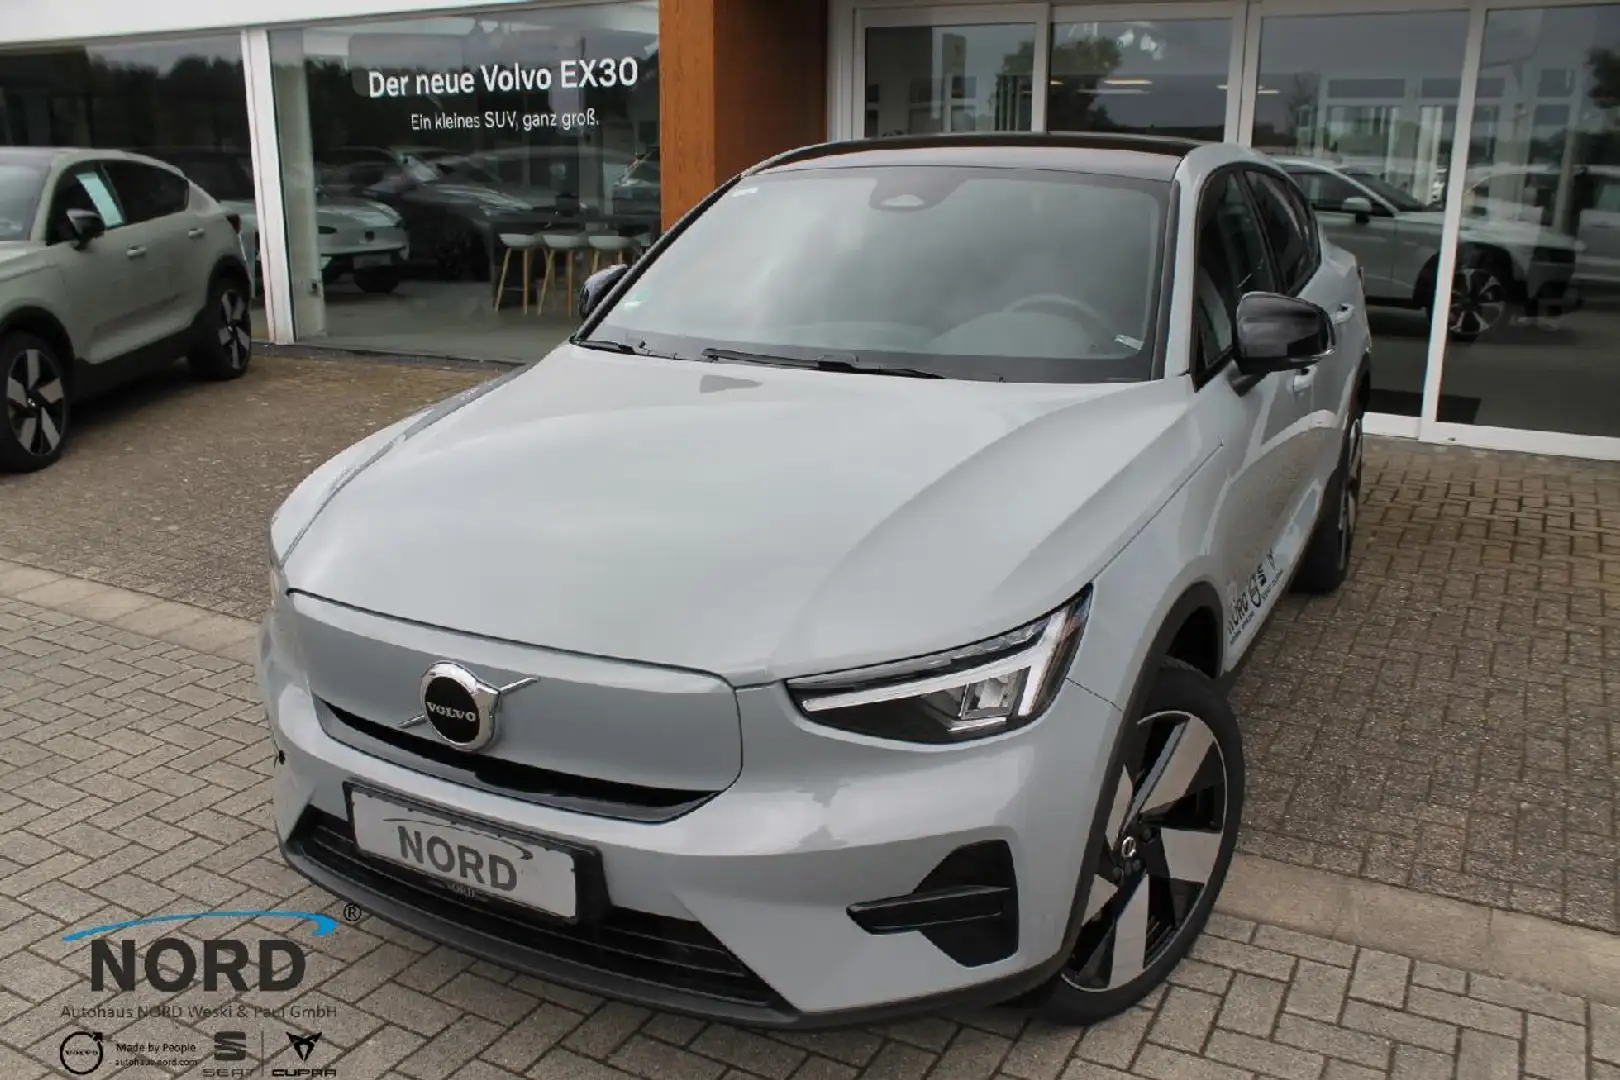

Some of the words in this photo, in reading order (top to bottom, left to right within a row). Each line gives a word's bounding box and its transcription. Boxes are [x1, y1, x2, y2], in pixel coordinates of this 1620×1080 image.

[368, 71, 409, 99] Der
[416, 71, 475, 95] neue
[480, 62, 552, 93] Volvo
[560, 57, 638, 89] EX30
[411, 113, 431, 131] Ein
[435, 111, 480, 129] kleines
[484, 111, 519, 131] SUV,
[523, 111, 557, 132] ganz
[561, 108, 599, 131] groß.
[426, 701, 476, 722] VOLVO
[397, 825, 517, 892] NORD
